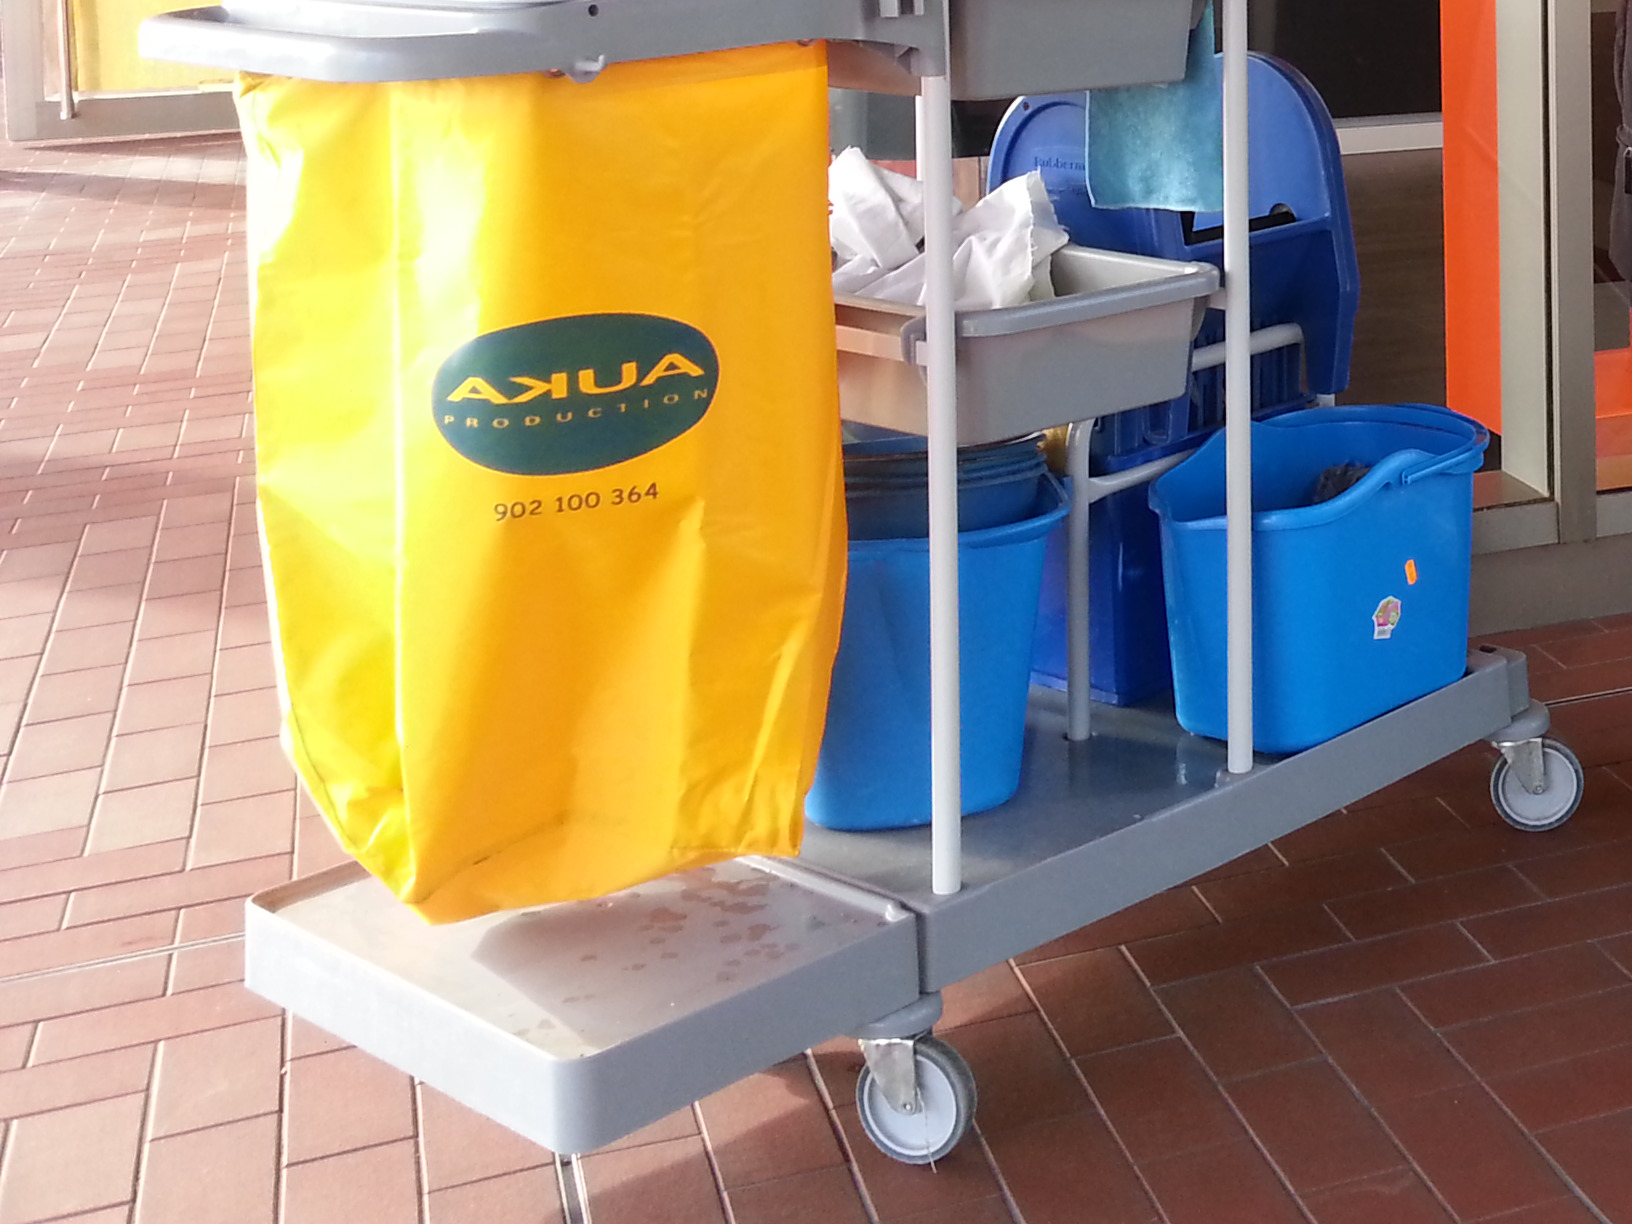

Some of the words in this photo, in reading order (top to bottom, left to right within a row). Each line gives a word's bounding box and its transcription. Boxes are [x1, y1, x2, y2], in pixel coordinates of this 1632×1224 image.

[447, 353, 705, 404] AKUA
[443, 388, 708, 428] PRODUCTION
[493, 499, 542, 522] 902
[555, 491, 601, 513] 100
[611, 482, 659, 507] 364
